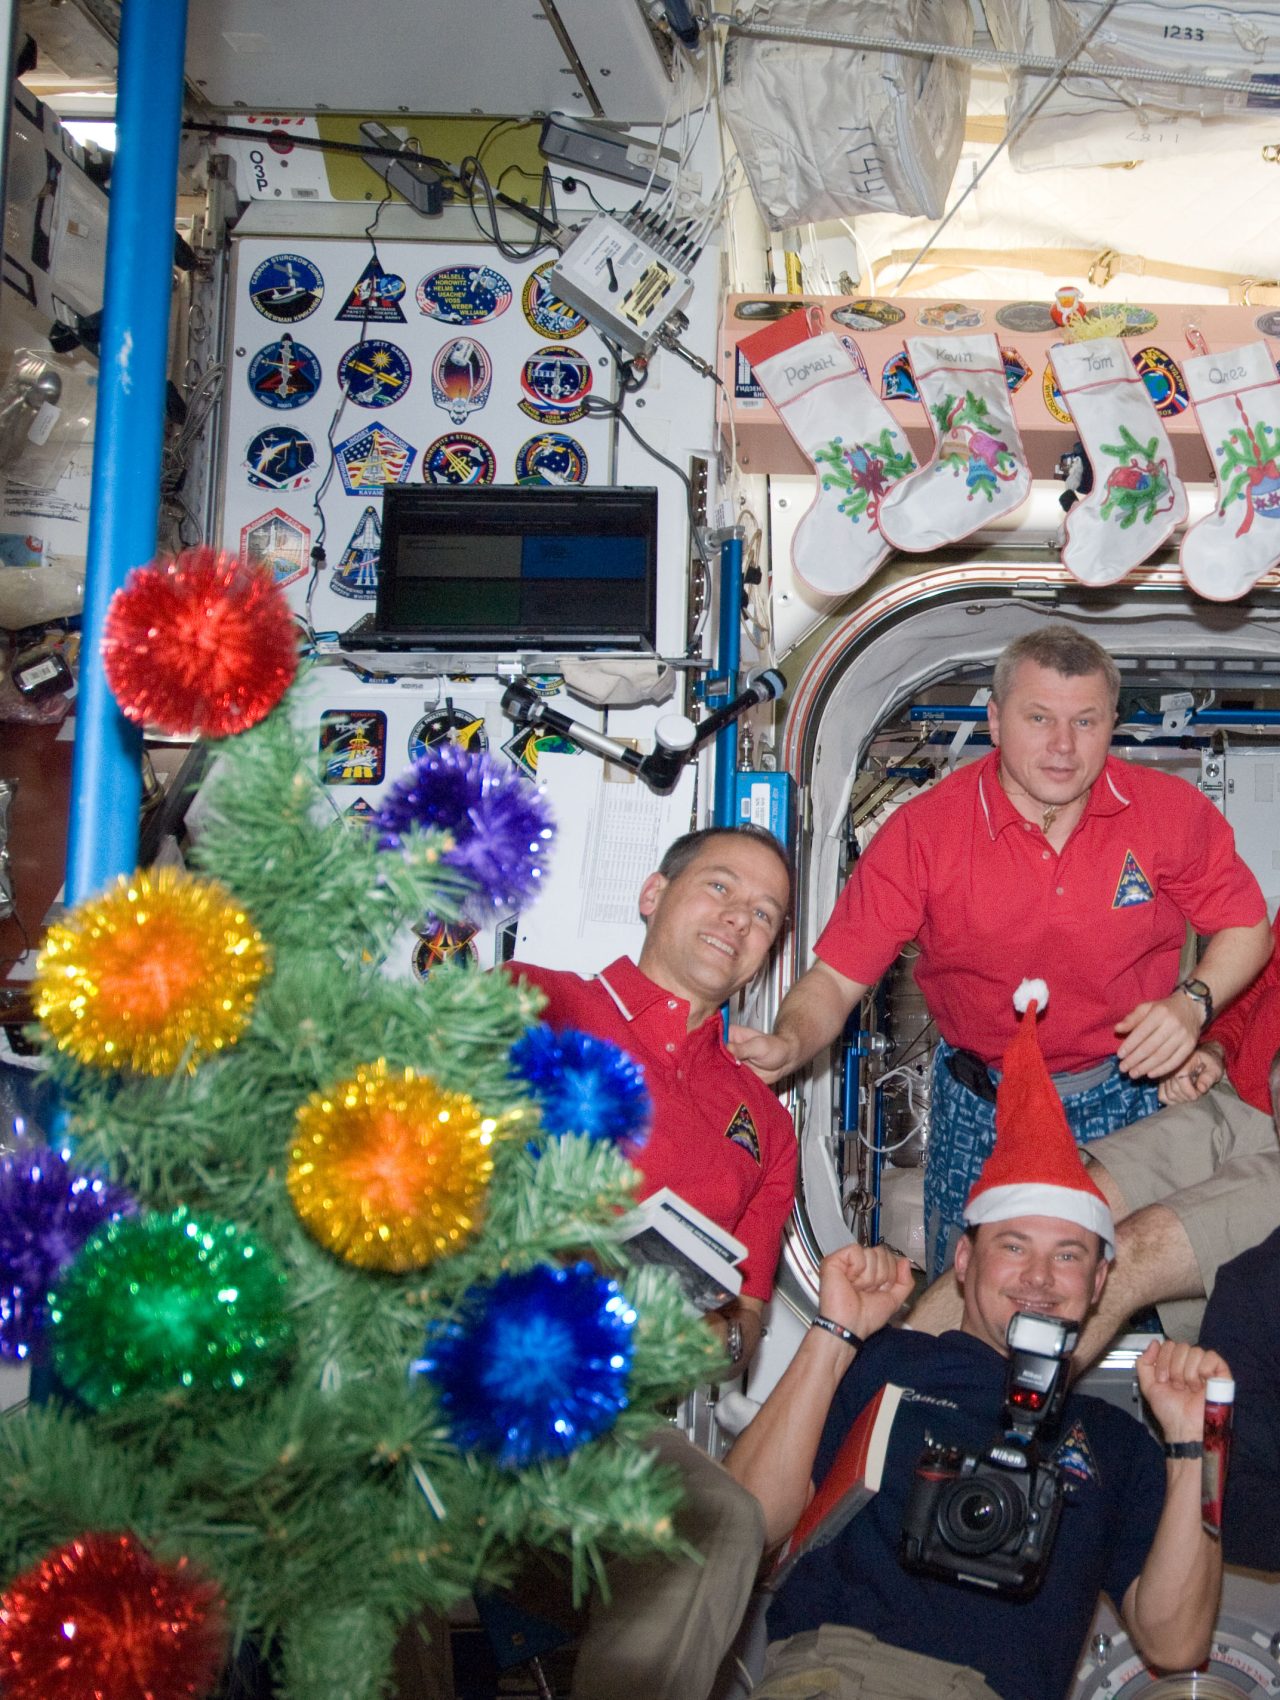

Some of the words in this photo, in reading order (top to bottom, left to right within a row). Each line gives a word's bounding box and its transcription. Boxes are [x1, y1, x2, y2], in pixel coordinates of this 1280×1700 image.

[1164, 26, 1204, 40] 1233
[252, 262, 271, 285] CABANA
[270, 254, 308, 266] STURCKOW
[264, 310, 293, 323] NEWMAN
[372, 342, 390, 350] JETT
[937, 349, 974, 362] Kevin
[1083, 353, 1114, 371] Tom
[1045, 384, 1061, 416] WHITSON
[346, 428, 370, 448] LINDSEY
[426, 437, 449, 462] HOROWITZ
[455, 434, 487, 451] STURCKOW
[571, 441, 586, 458] KELLY
[1022, 1370, 1042, 1380] Nikon
[902, 1388, 959, 1410] Roman
[990, 1448, 1022, 1464] Nikon
